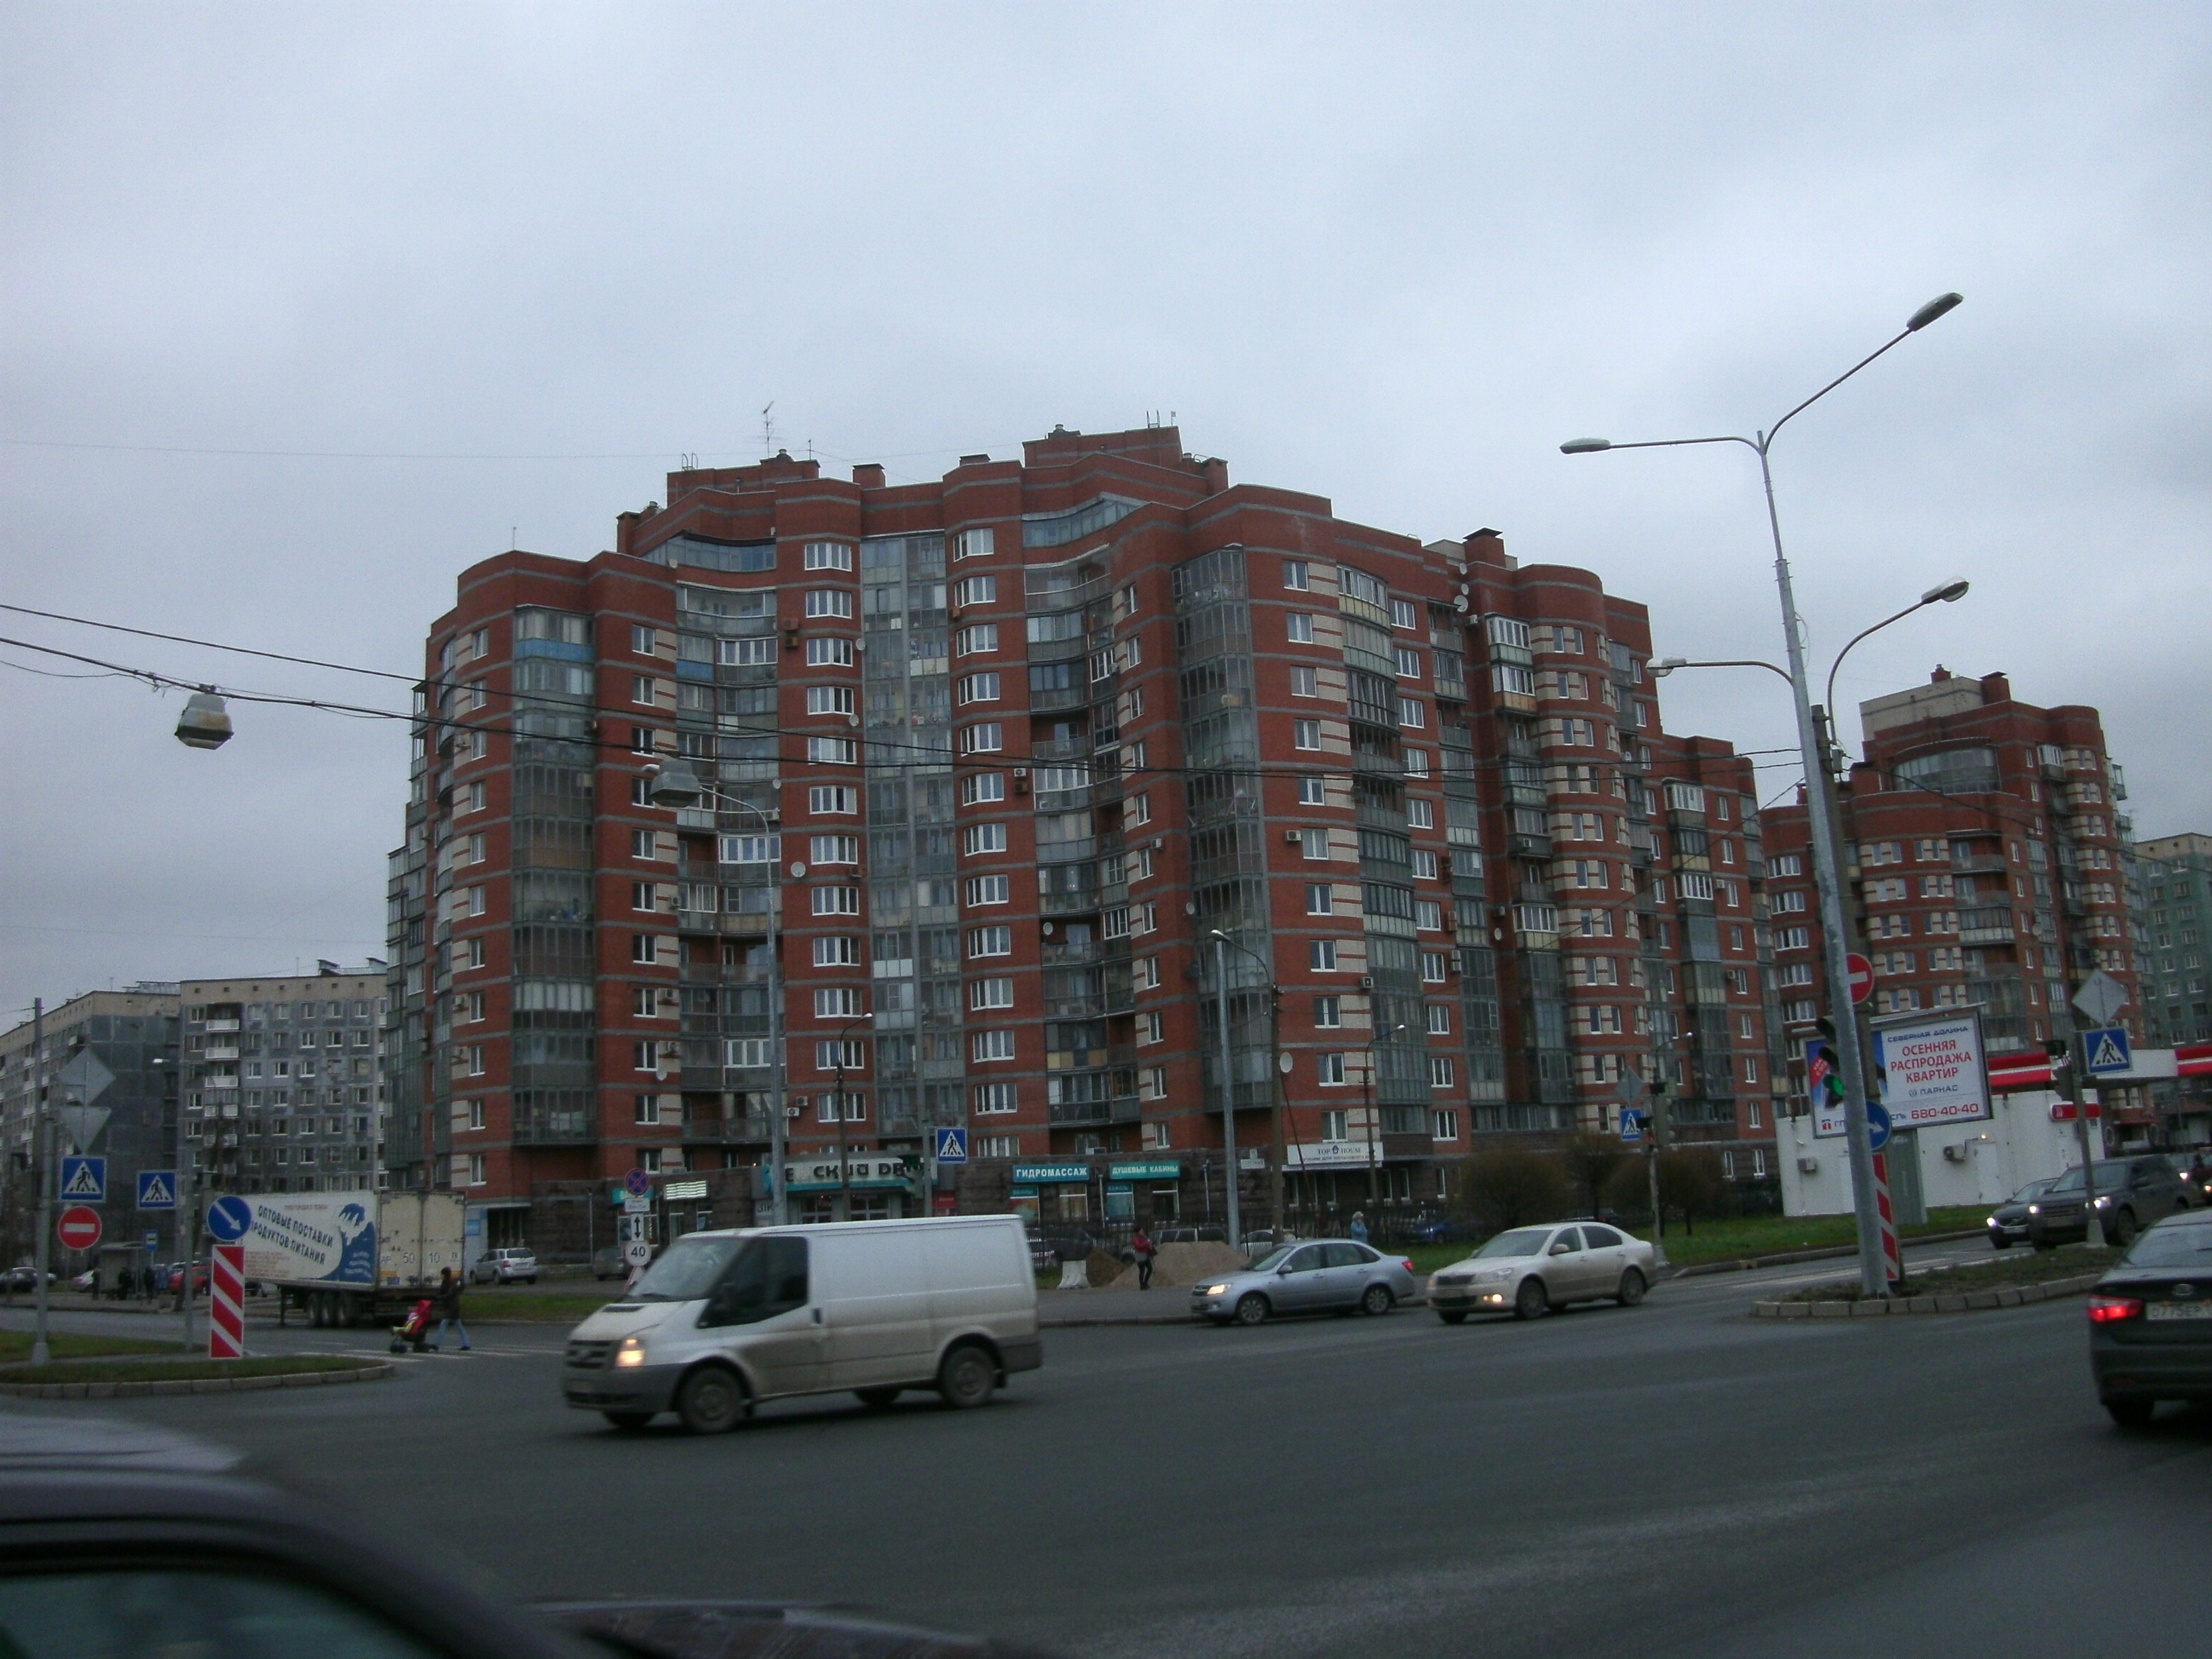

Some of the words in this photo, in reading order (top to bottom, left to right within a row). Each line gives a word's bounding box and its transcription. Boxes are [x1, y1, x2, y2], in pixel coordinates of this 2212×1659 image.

[1887, 1031, 1931, 1042] СЕВЕРНАЯ
[1933, 1026, 1968, 1036] ДОЛИНА
[1902, 1039, 1957, 1057] ОСЕННЯЯ
[1890, 1051, 1972, 1071] РАСПРОДАЖА
[1906, 1067, 1959, 1084] КВАРТИР
[1920, 1084, 1958, 1095] ПАРНАС
[1911, 1103, 1979, 1120] 680-40-40
[1016, 1167, 1088, 1179] ГИДРОМАССАЖ
[1112, 1166, 1147, 1175] ДУШЕВЫЕ
[757, 1202, 775, 1212] JIK
[258, 1205, 291, 1229] ОПТОВЫЕ
[292, 1221, 334, 1248] ПОСТАВКИ
[290, 1238, 326, 1265] ПИТАНИЯ
[403, 1252, 415, 1264] 50
[429, 1252, 441, 1264] 10
[631, 1246, 646, 1258] 40
